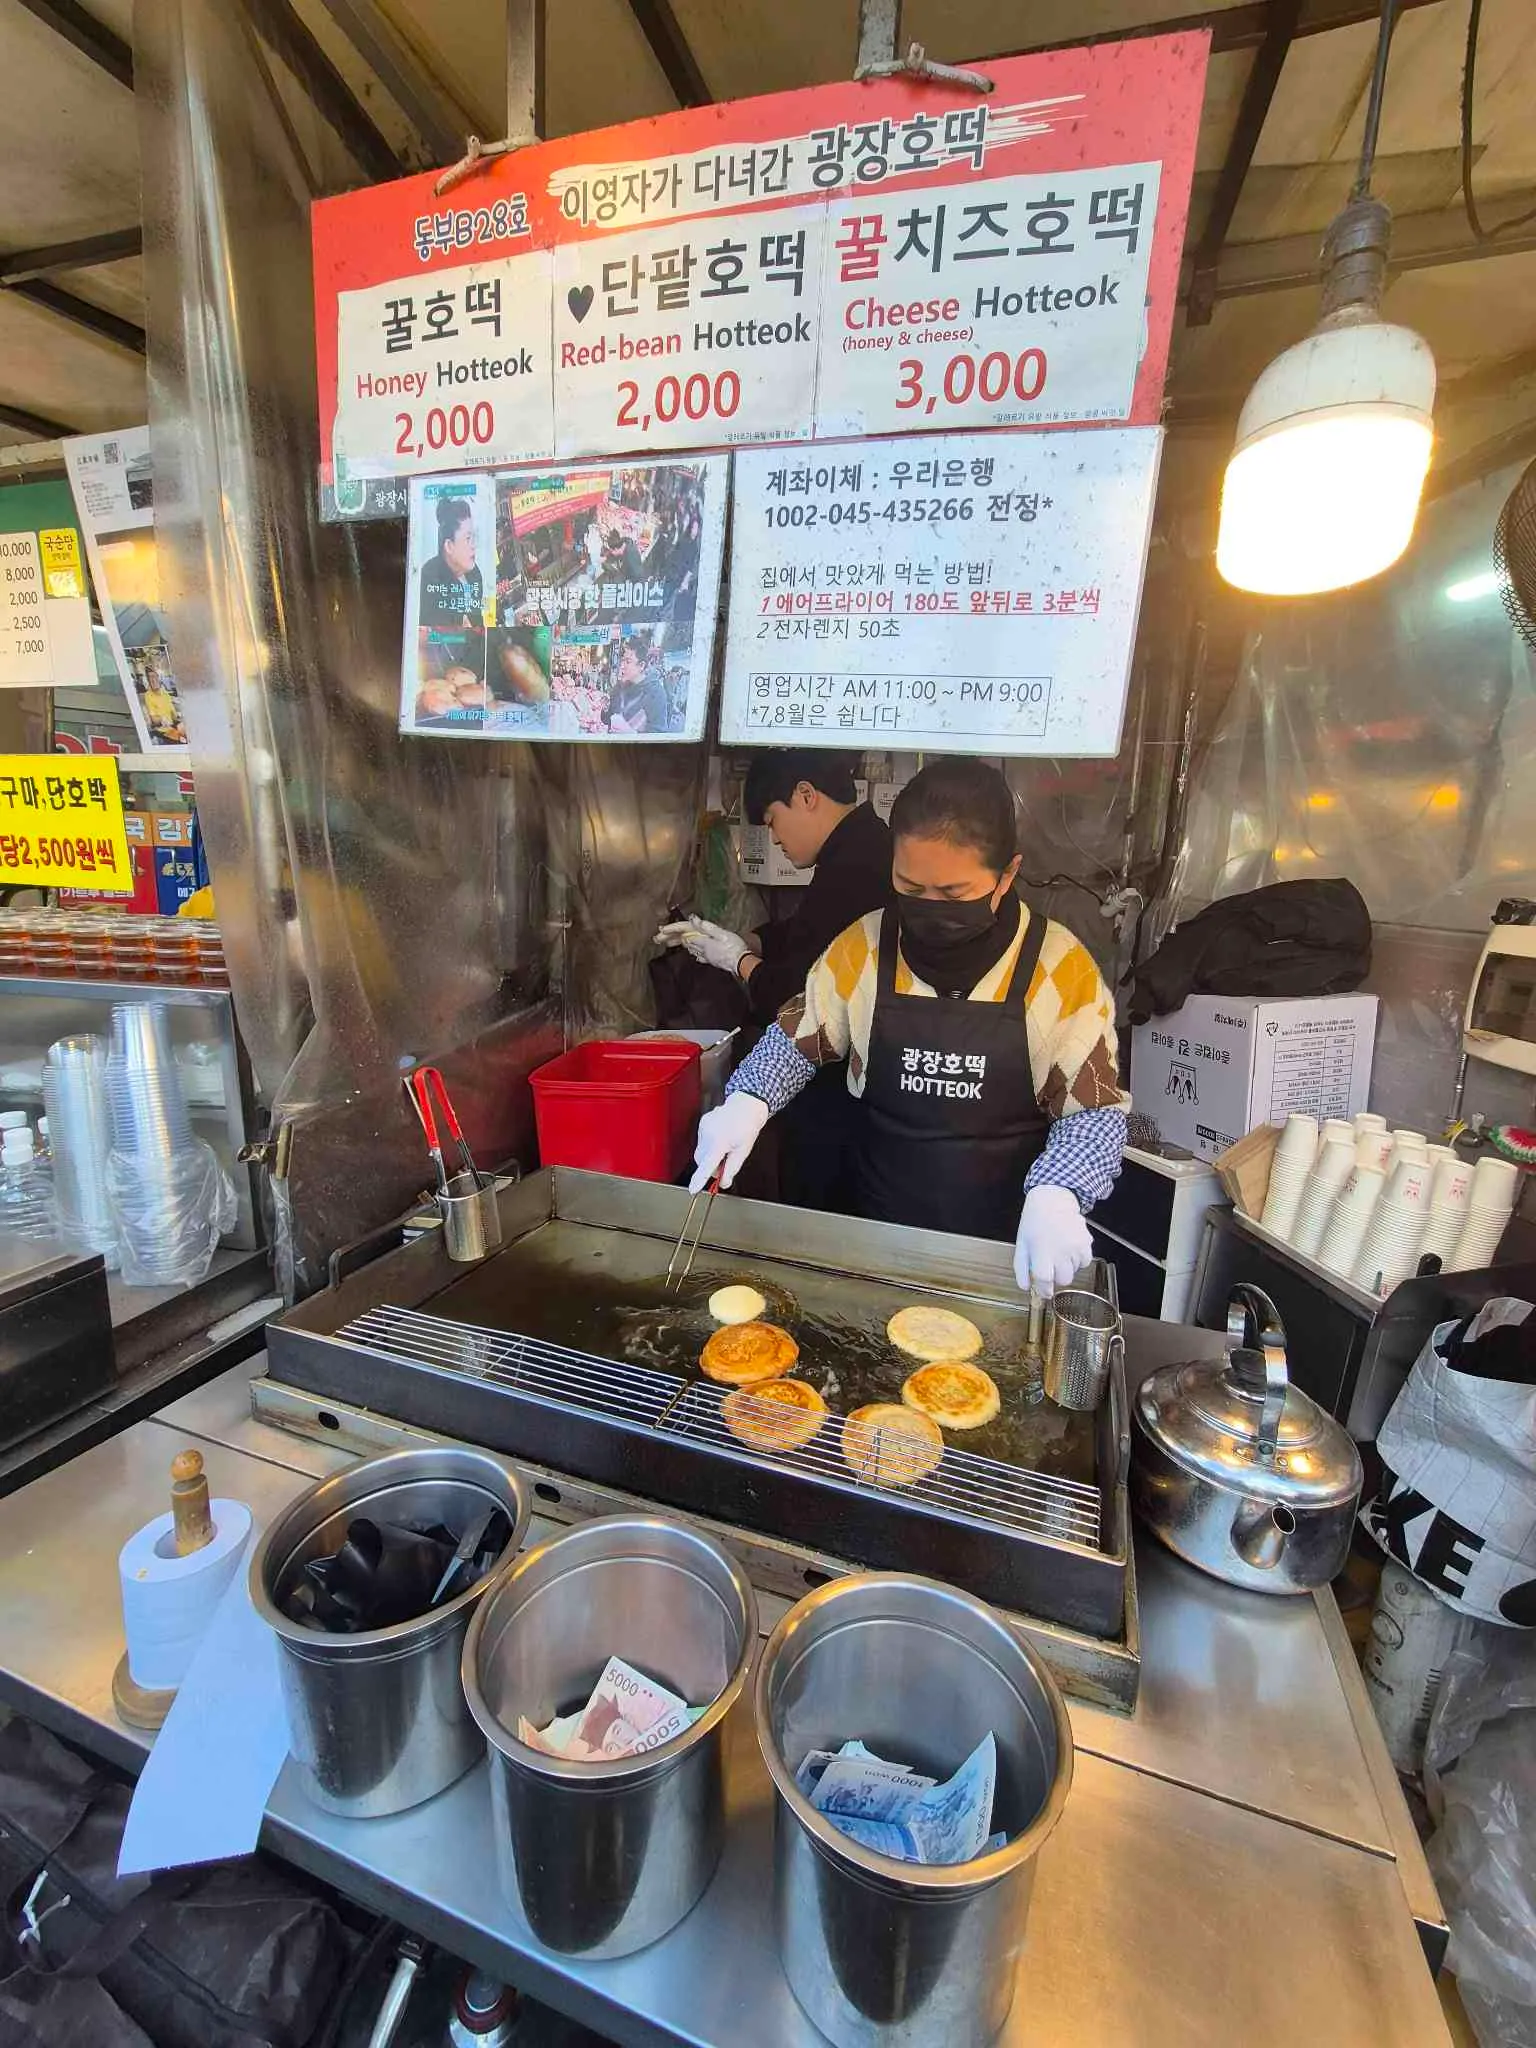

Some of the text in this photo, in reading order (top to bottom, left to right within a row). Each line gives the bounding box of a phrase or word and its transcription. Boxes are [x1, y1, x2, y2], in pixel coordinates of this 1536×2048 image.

[563, 105, 991, 224] 이영자가 다녀간 광장호떡
[415, 193, 531, 261] 동부B28호
[835, 182, 1145, 282] 꿀치즈호떡
[601, 229, 807, 318] 단팥호떡
[381, 278, 502, 354] 꿀호떡
[844, 274, 1121, 331] Cheese Hotteok
[560, 312, 811, 369] Red-bean Hotteok
[842, 326, 974, 354] (honey & cheese)
[356, 347, 534, 399] Honey Hotteok
[895, 347, 1048, 415] 3,000
[616, 370, 742, 432] 2,000
[394, 401, 495, 458] 2,000
[765, 462, 862, 497] 계좌이체
[889, 457, 995, 491] 우리은행
[764, 497, 974, 528] 1002-045-435266
[6, 566, 35, 582] 8,000
[761, 565, 817, 589] 집에서
[895, 561, 935, 585] 먹는
[944, 561, 992, 585] 방법!
[10, 591, 38, 607] 2,000
[761, 588, 1101, 614] 1 에어프라이어 180도 앞뒤로 3분씩
[13, 615, 41, 631] 2,500
[757, 617, 901, 640] 2 전자렌지 50초
[15, 639, 45, 654] 7,000
[754, 675, 837, 699] 영업시간
[843, 679, 877, 699] AM
[883, 679, 936, 700] 11:00
[960, 681, 994, 702] PM
[999, 682, 1043, 703] 9:00
[836, 703, 901, 729] 쉽니다
[901, 1047, 986, 1079] 광장호떡
[900, 1073, 984, 1100] HOTTEOK
[606, 1668, 640, 1697] 5000
[634, 1714, 681, 1755] 5000
